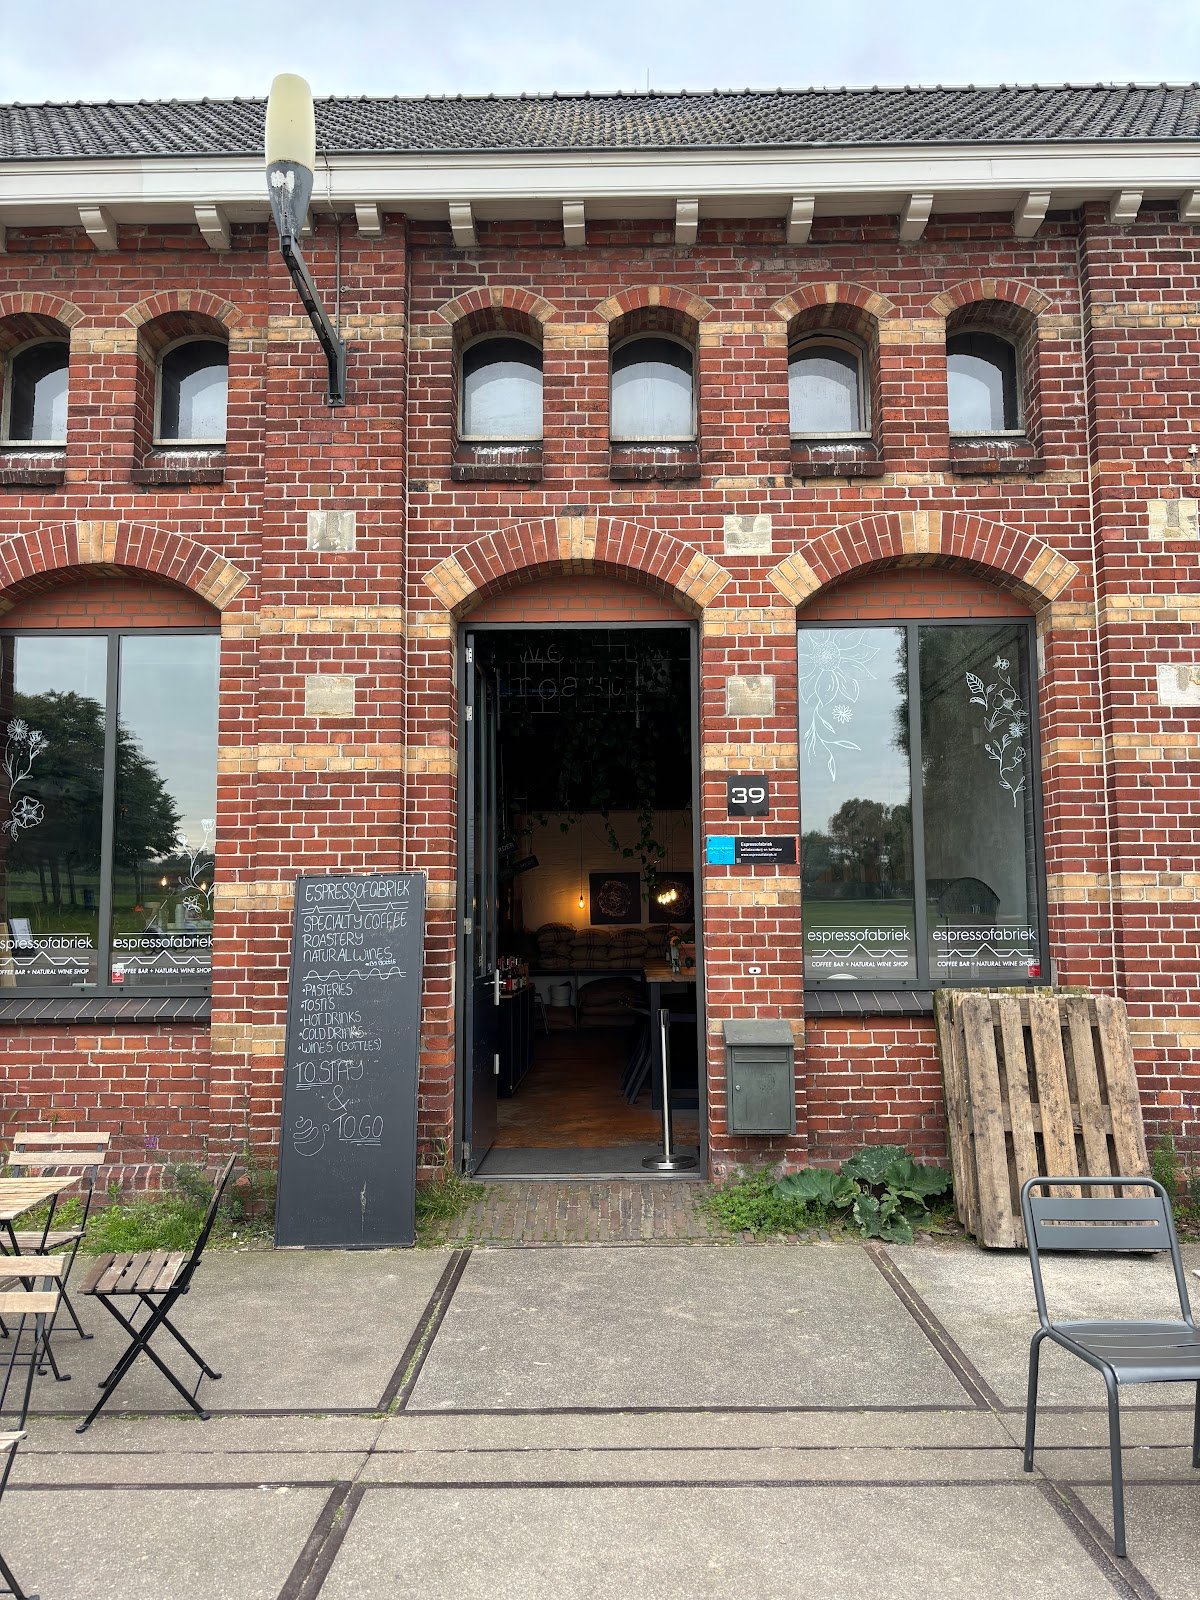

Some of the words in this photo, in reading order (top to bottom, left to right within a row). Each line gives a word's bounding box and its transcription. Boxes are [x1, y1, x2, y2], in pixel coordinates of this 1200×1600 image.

[731, 787, 765, 804] 39
[303, 914, 363, 933] SPECIALTY
[364, 911, 408, 930] COFFEE
[0, 936, 93, 951] spressofabriek
[114, 935, 213, 951] espressofabriek
[302, 931, 364, 948] ROASTERY
[807, 928, 911, 944] espressofabriek
[932, 927, 1037, 944] espressofabriek
[303, 947, 352, 962] NATURAL
[304, 982, 353, 997] PASTERIES
[303, 1012, 323, 1027] HOT
[324, 1010, 362, 1026] DRINKS
[302, 1027, 326, 1040] COLD
[301, 1040, 333, 1054] WINES
[336, 1037, 382, 1053] (BOTTLES)
[292, 1061, 316, 1083] TO
[318, 1058, 364, 1083] STAY
[327, 1084, 350, 1111] &
[332, 1112, 356, 1139] TO
[358, 1114, 384, 1139] GO
